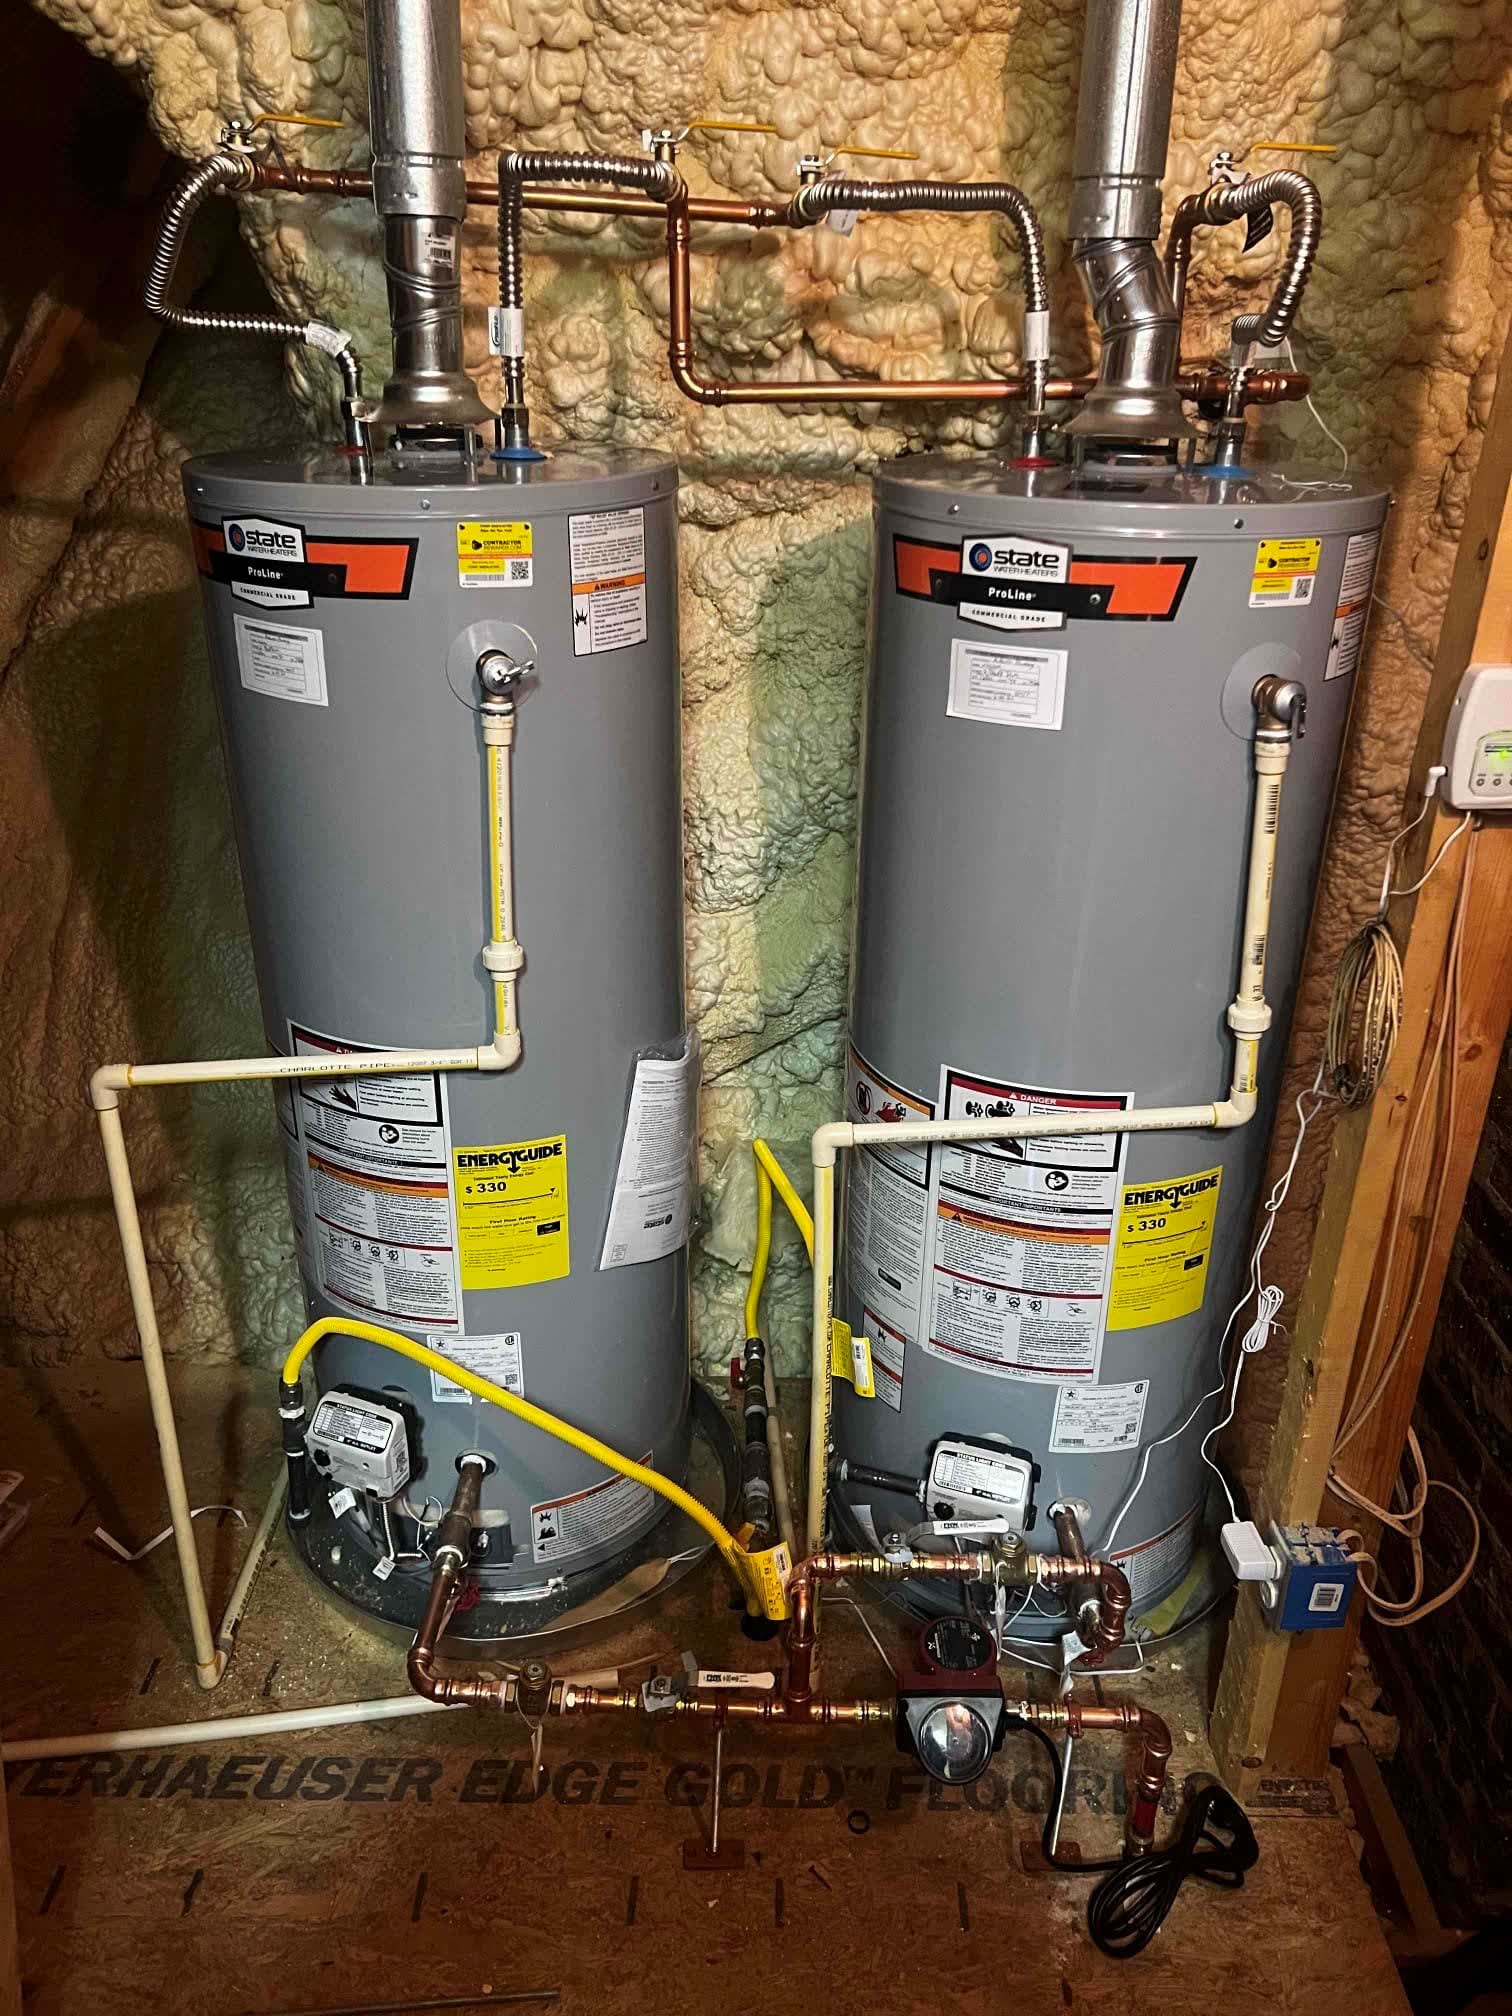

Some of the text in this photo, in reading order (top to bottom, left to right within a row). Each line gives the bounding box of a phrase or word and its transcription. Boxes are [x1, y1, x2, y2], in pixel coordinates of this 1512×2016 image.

[246, 530, 296, 549] state
[994, 549, 1060, 569] state
[247, 566, 282, 580] ProLine
[994, 566, 1058, 577] WATER HEATERS
[240, 587, 296, 600] COMMERCIAL GRADE
[988, 587, 1032, 601] ProLine
[972, 609, 1046, 623] COMMERCIAL GRADE
[280, 1064, 352, 1073] CHARLOTTE
[1020, 1094, 1057, 1106] DANGER
[457, 1143, 563, 1172] ENERGYGUIDE
[476, 1181, 507, 1193] 330
[1124, 1174, 1219, 1206] ENERGYGUIDE
[1138, 1218, 1166, 1231] 330
[459, 1758, 650, 1806] EDGE
